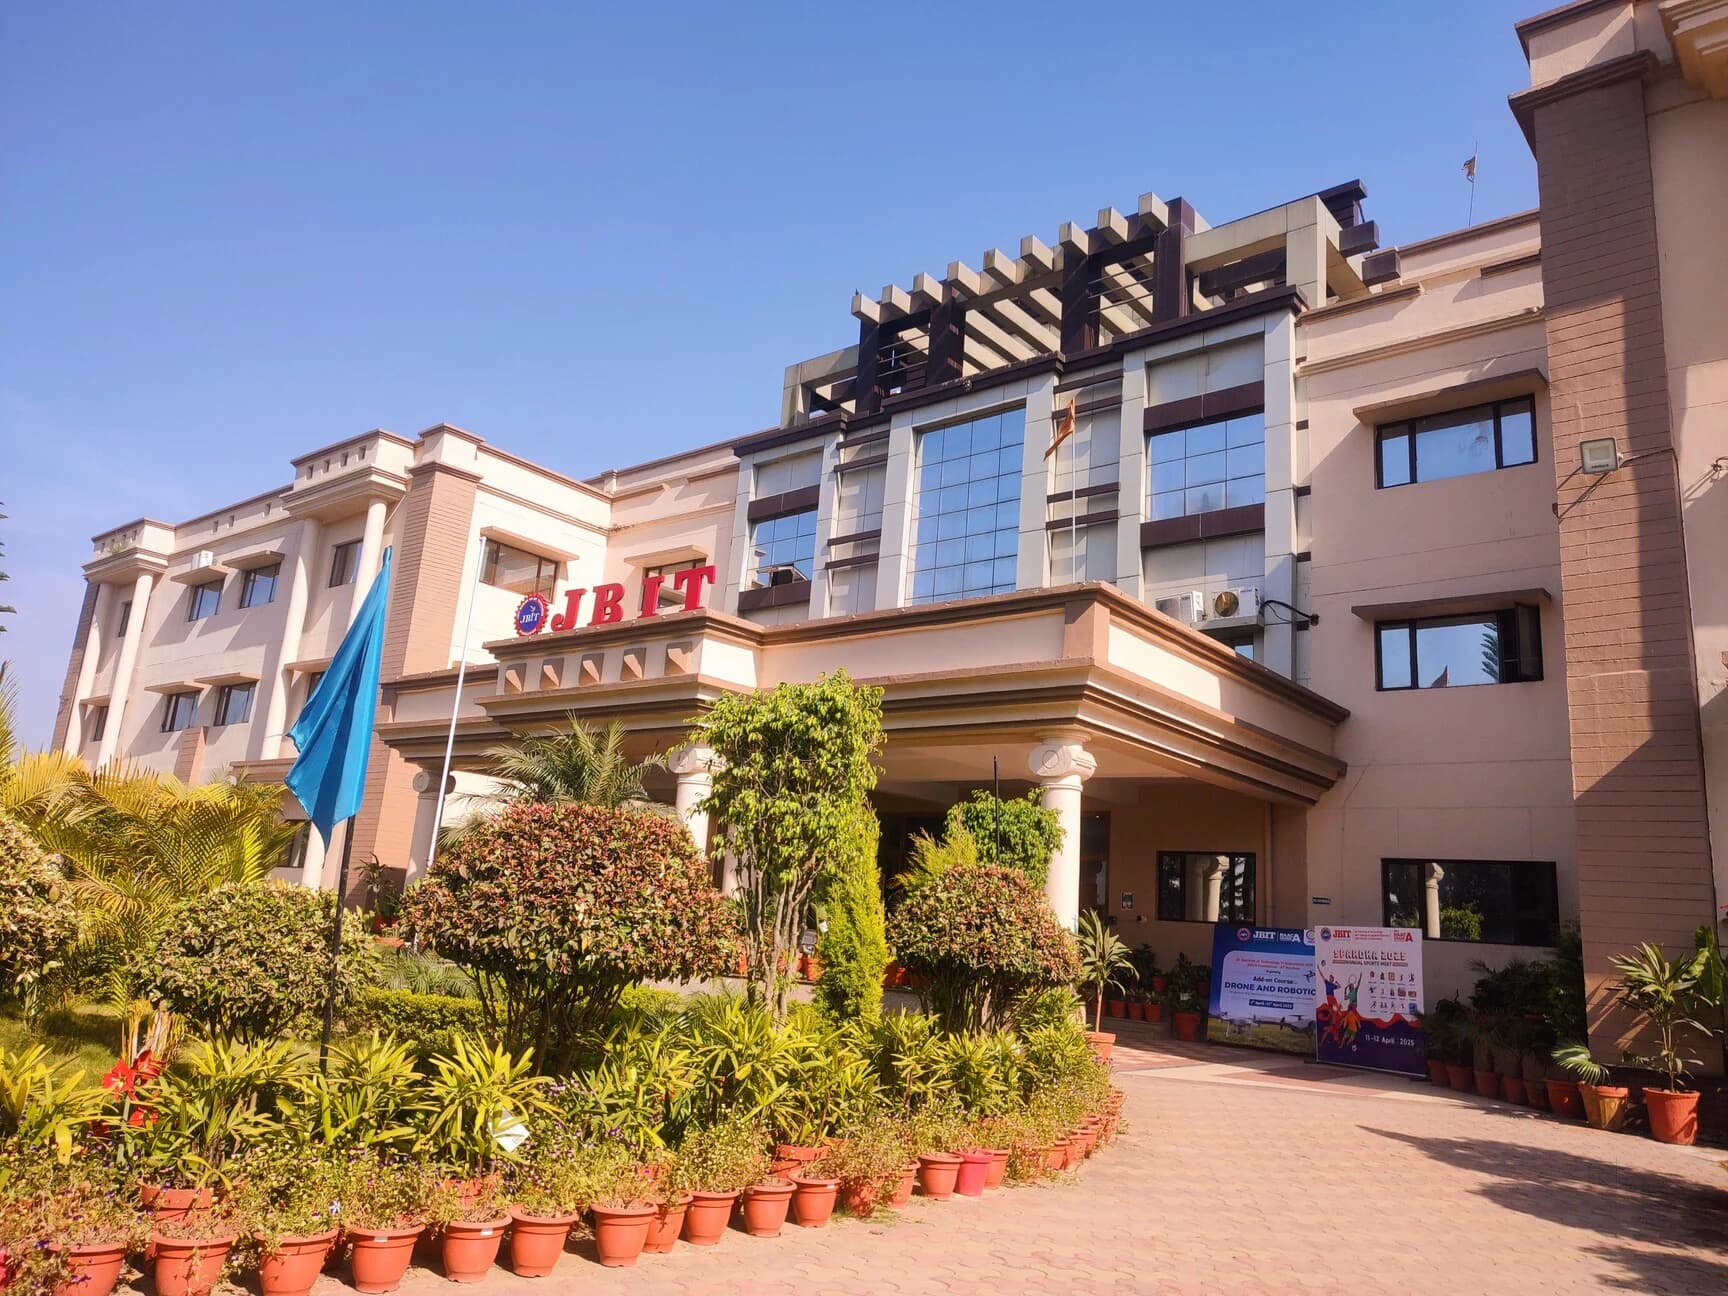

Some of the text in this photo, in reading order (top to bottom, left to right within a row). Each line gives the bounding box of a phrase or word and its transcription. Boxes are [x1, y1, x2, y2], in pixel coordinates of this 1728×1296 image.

[551, 565, 716, 632] JBIT
[520, 612, 540, 624] JBIT
[1253, 931, 1276, 939] JBIT
[1333, 930, 1351, 938] JBIT
[1224, 982, 1256, 991] DRONE
[1257, 984, 1276, 992] AND
[1399, 1037, 1415, 1046] 2025
